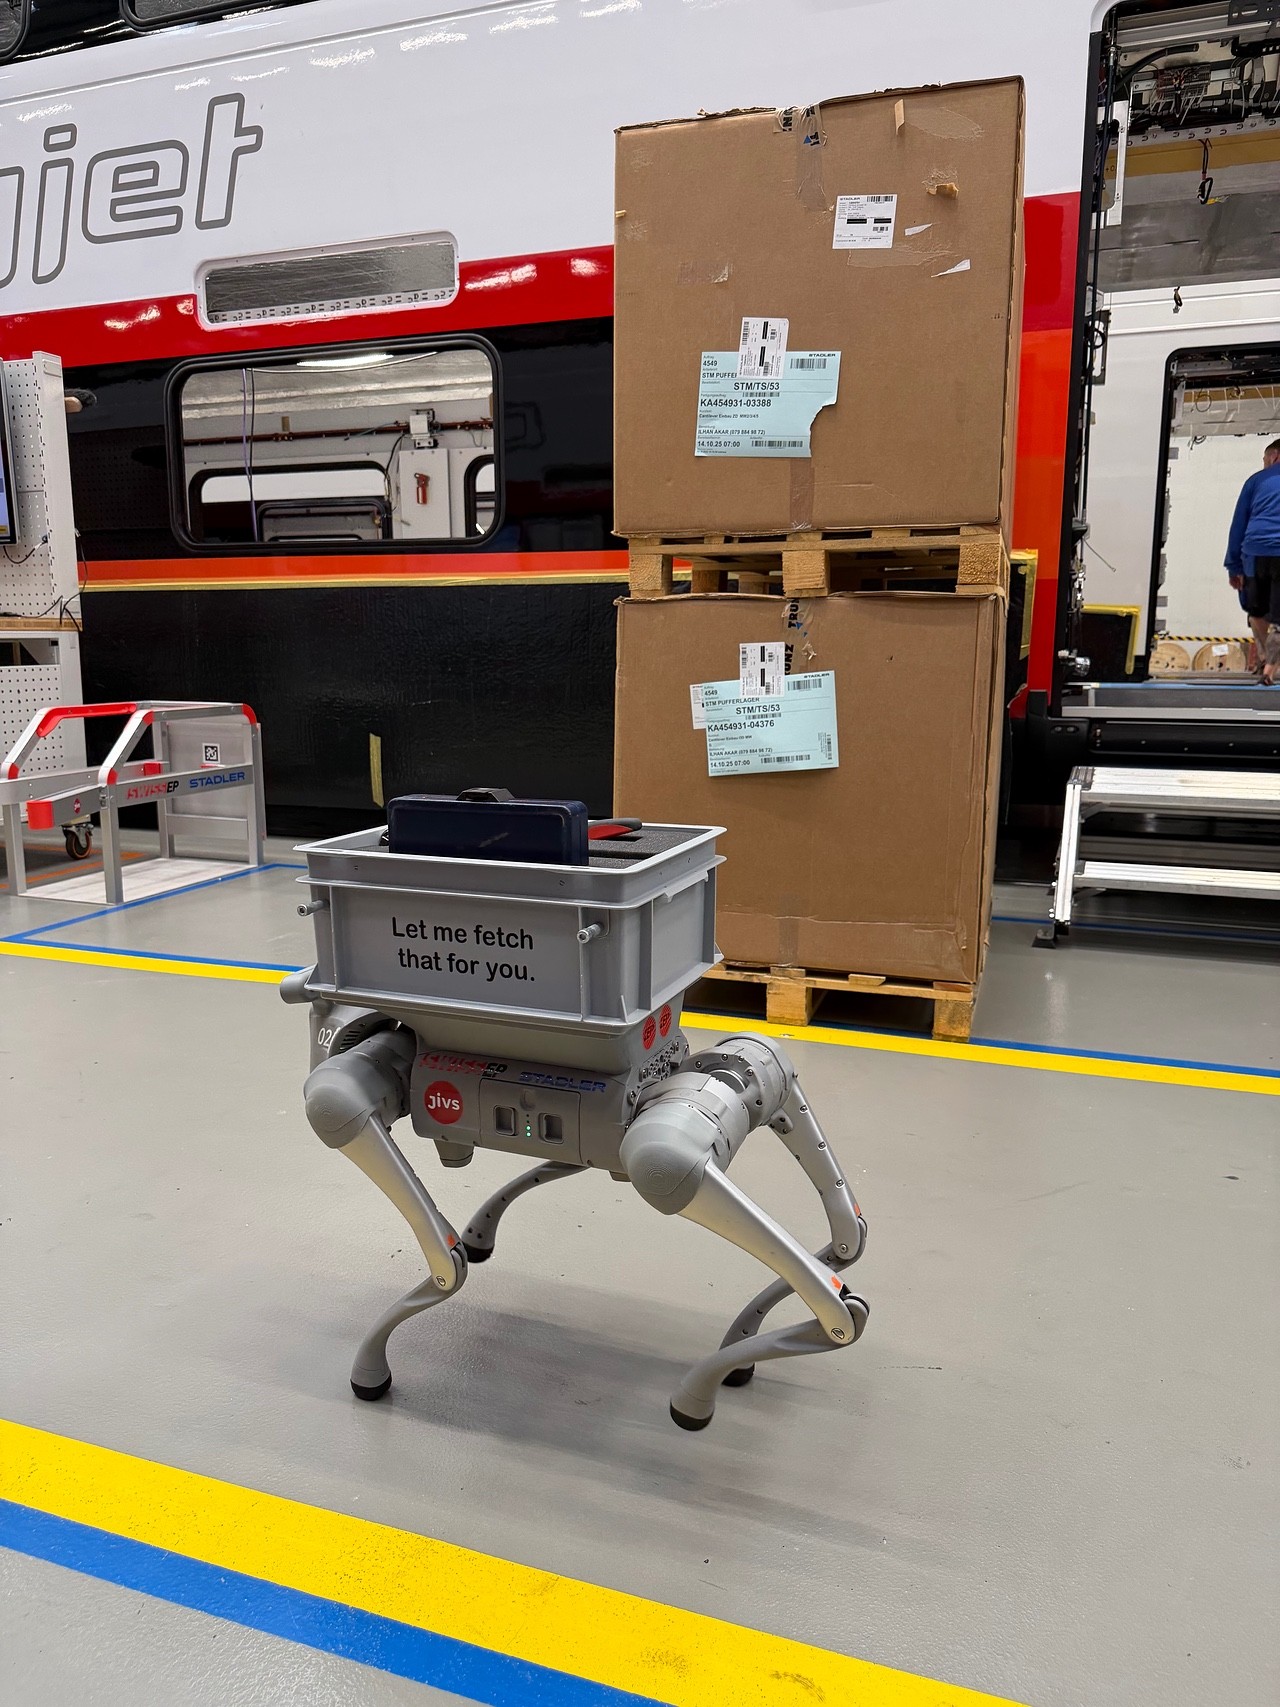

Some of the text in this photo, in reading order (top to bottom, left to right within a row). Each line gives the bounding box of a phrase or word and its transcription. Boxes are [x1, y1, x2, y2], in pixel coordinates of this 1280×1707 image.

[0, 92, 263, 288] jet
[734, 382, 780, 390] STM/TS/53
[700, 399, 771, 407] KA454931-03388
[785, 644, 794, 675] UNZ
[736, 704, 780, 714] STM/TS/53
[708, 720, 774, 732] KA454931-04376
[189, 771, 245, 788] STADLER
[392, 917, 533, 949] Let me fetch
[398, 948, 534, 981] that for you.
[518, 1071, 606, 1093] STADLER
